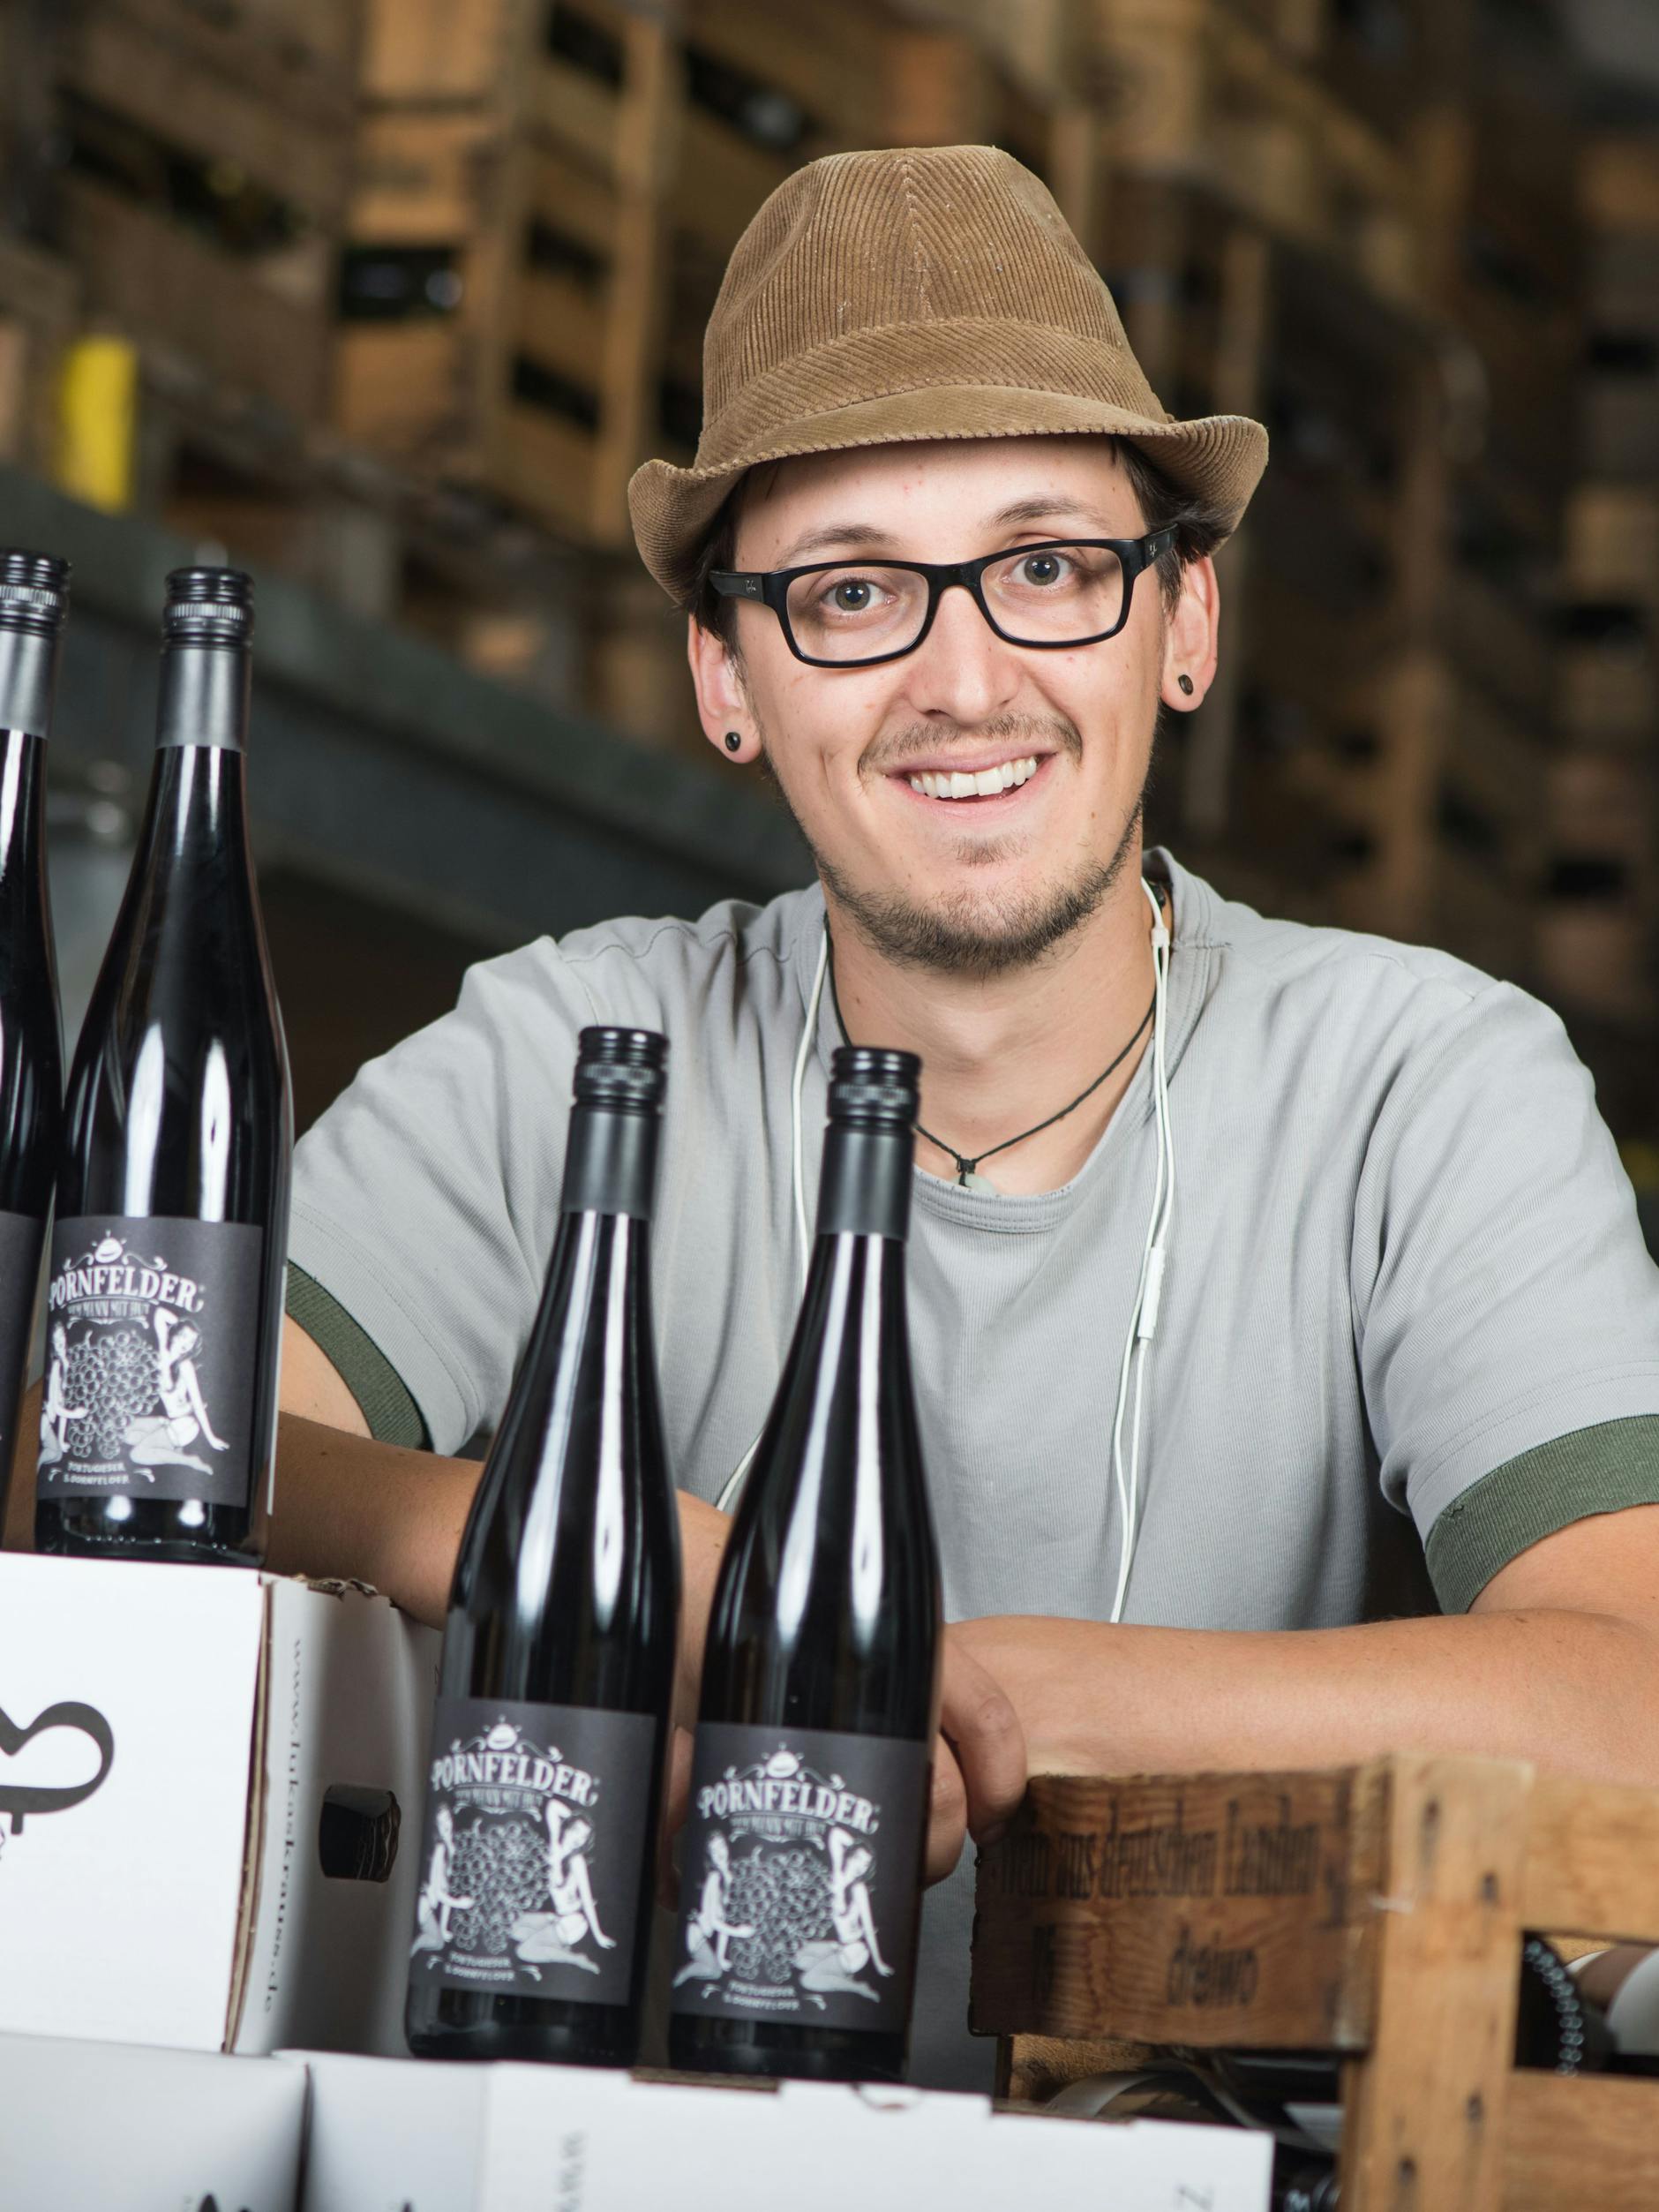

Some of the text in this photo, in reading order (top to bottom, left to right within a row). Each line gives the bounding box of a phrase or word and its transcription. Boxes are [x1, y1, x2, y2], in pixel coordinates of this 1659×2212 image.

[49, 1264, 205, 1313] PORNFELDER
[431, 1751, 599, 1807] PORNFELDER
[697, 1779, 879, 1834] PORNFELDER
